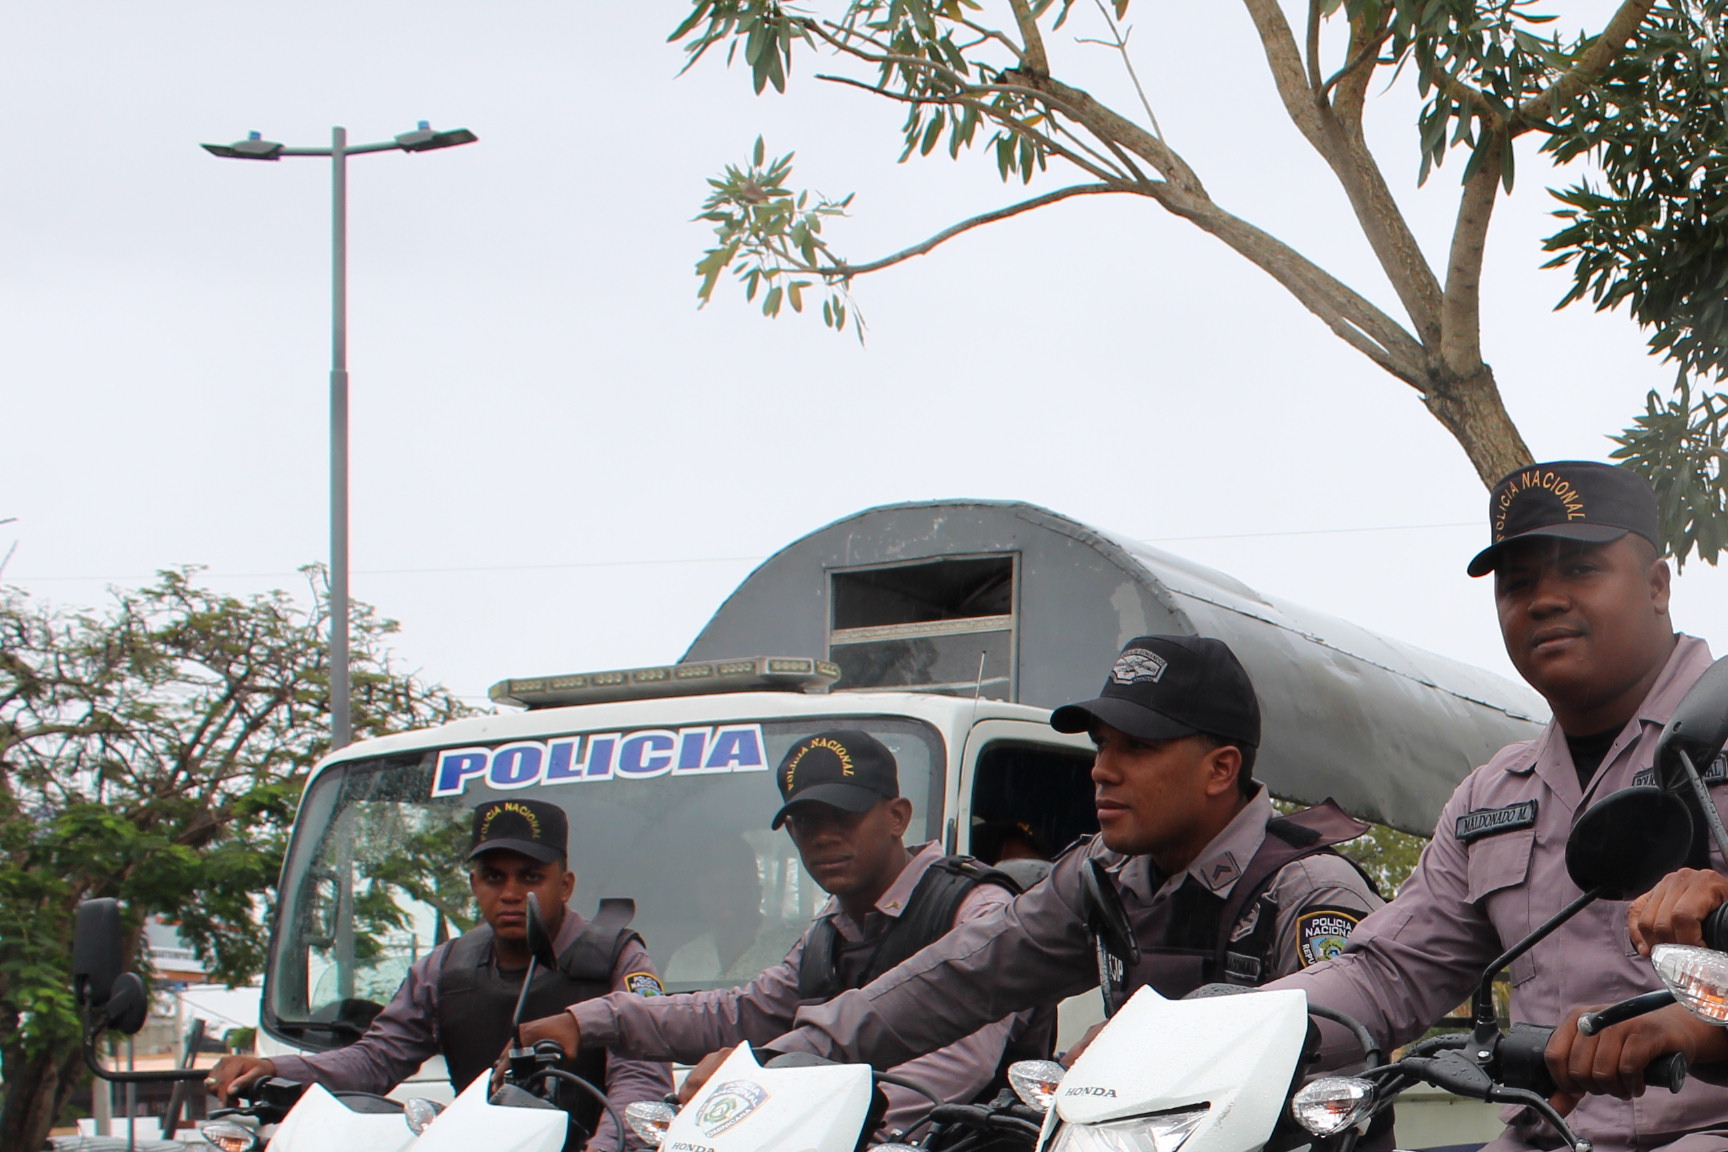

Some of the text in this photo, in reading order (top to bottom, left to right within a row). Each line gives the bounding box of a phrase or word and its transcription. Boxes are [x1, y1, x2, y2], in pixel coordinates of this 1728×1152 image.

[1496, 470, 1586, 542] POLICIA NACIONAL
[431, 723, 769, 798] POLICIA
[810, 737, 855, 777] NACIONAL
[504, 802, 541, 839] NACIONAL
[1463, 809, 1516, 834] MALDONADO
[1305, 927, 1352, 938] NACIONA
[1311, 917, 1352, 930] POLICIA
[1064, 1086, 1118, 1098] HONDA
